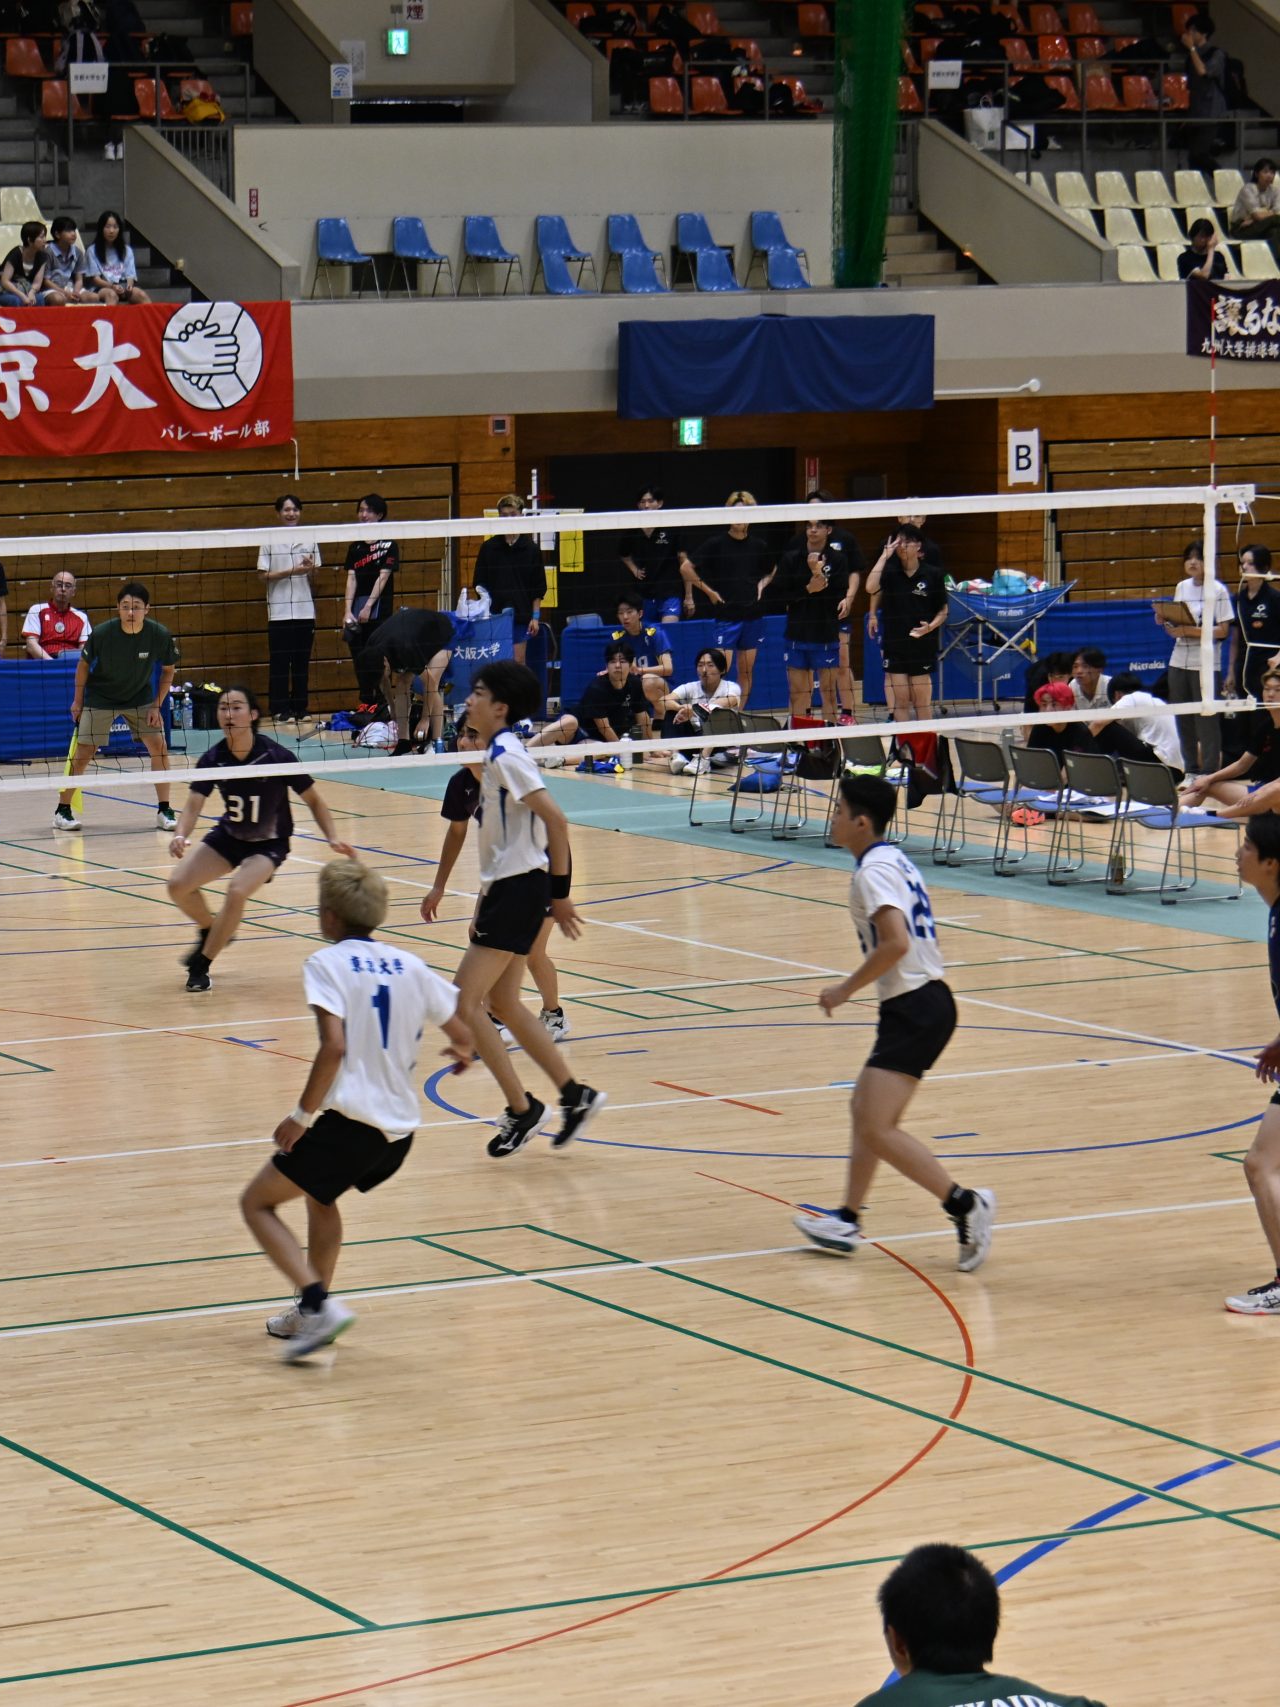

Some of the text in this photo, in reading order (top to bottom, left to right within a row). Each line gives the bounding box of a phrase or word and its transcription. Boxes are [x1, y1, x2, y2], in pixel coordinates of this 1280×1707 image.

[161, 420, 270, 441] バレーボール部
[1015, 445, 1032, 471] B
[453, 642, 501, 660] 大阪大学
[227, 795, 261, 823] 31
[371, 984, 390, 1050] 1
